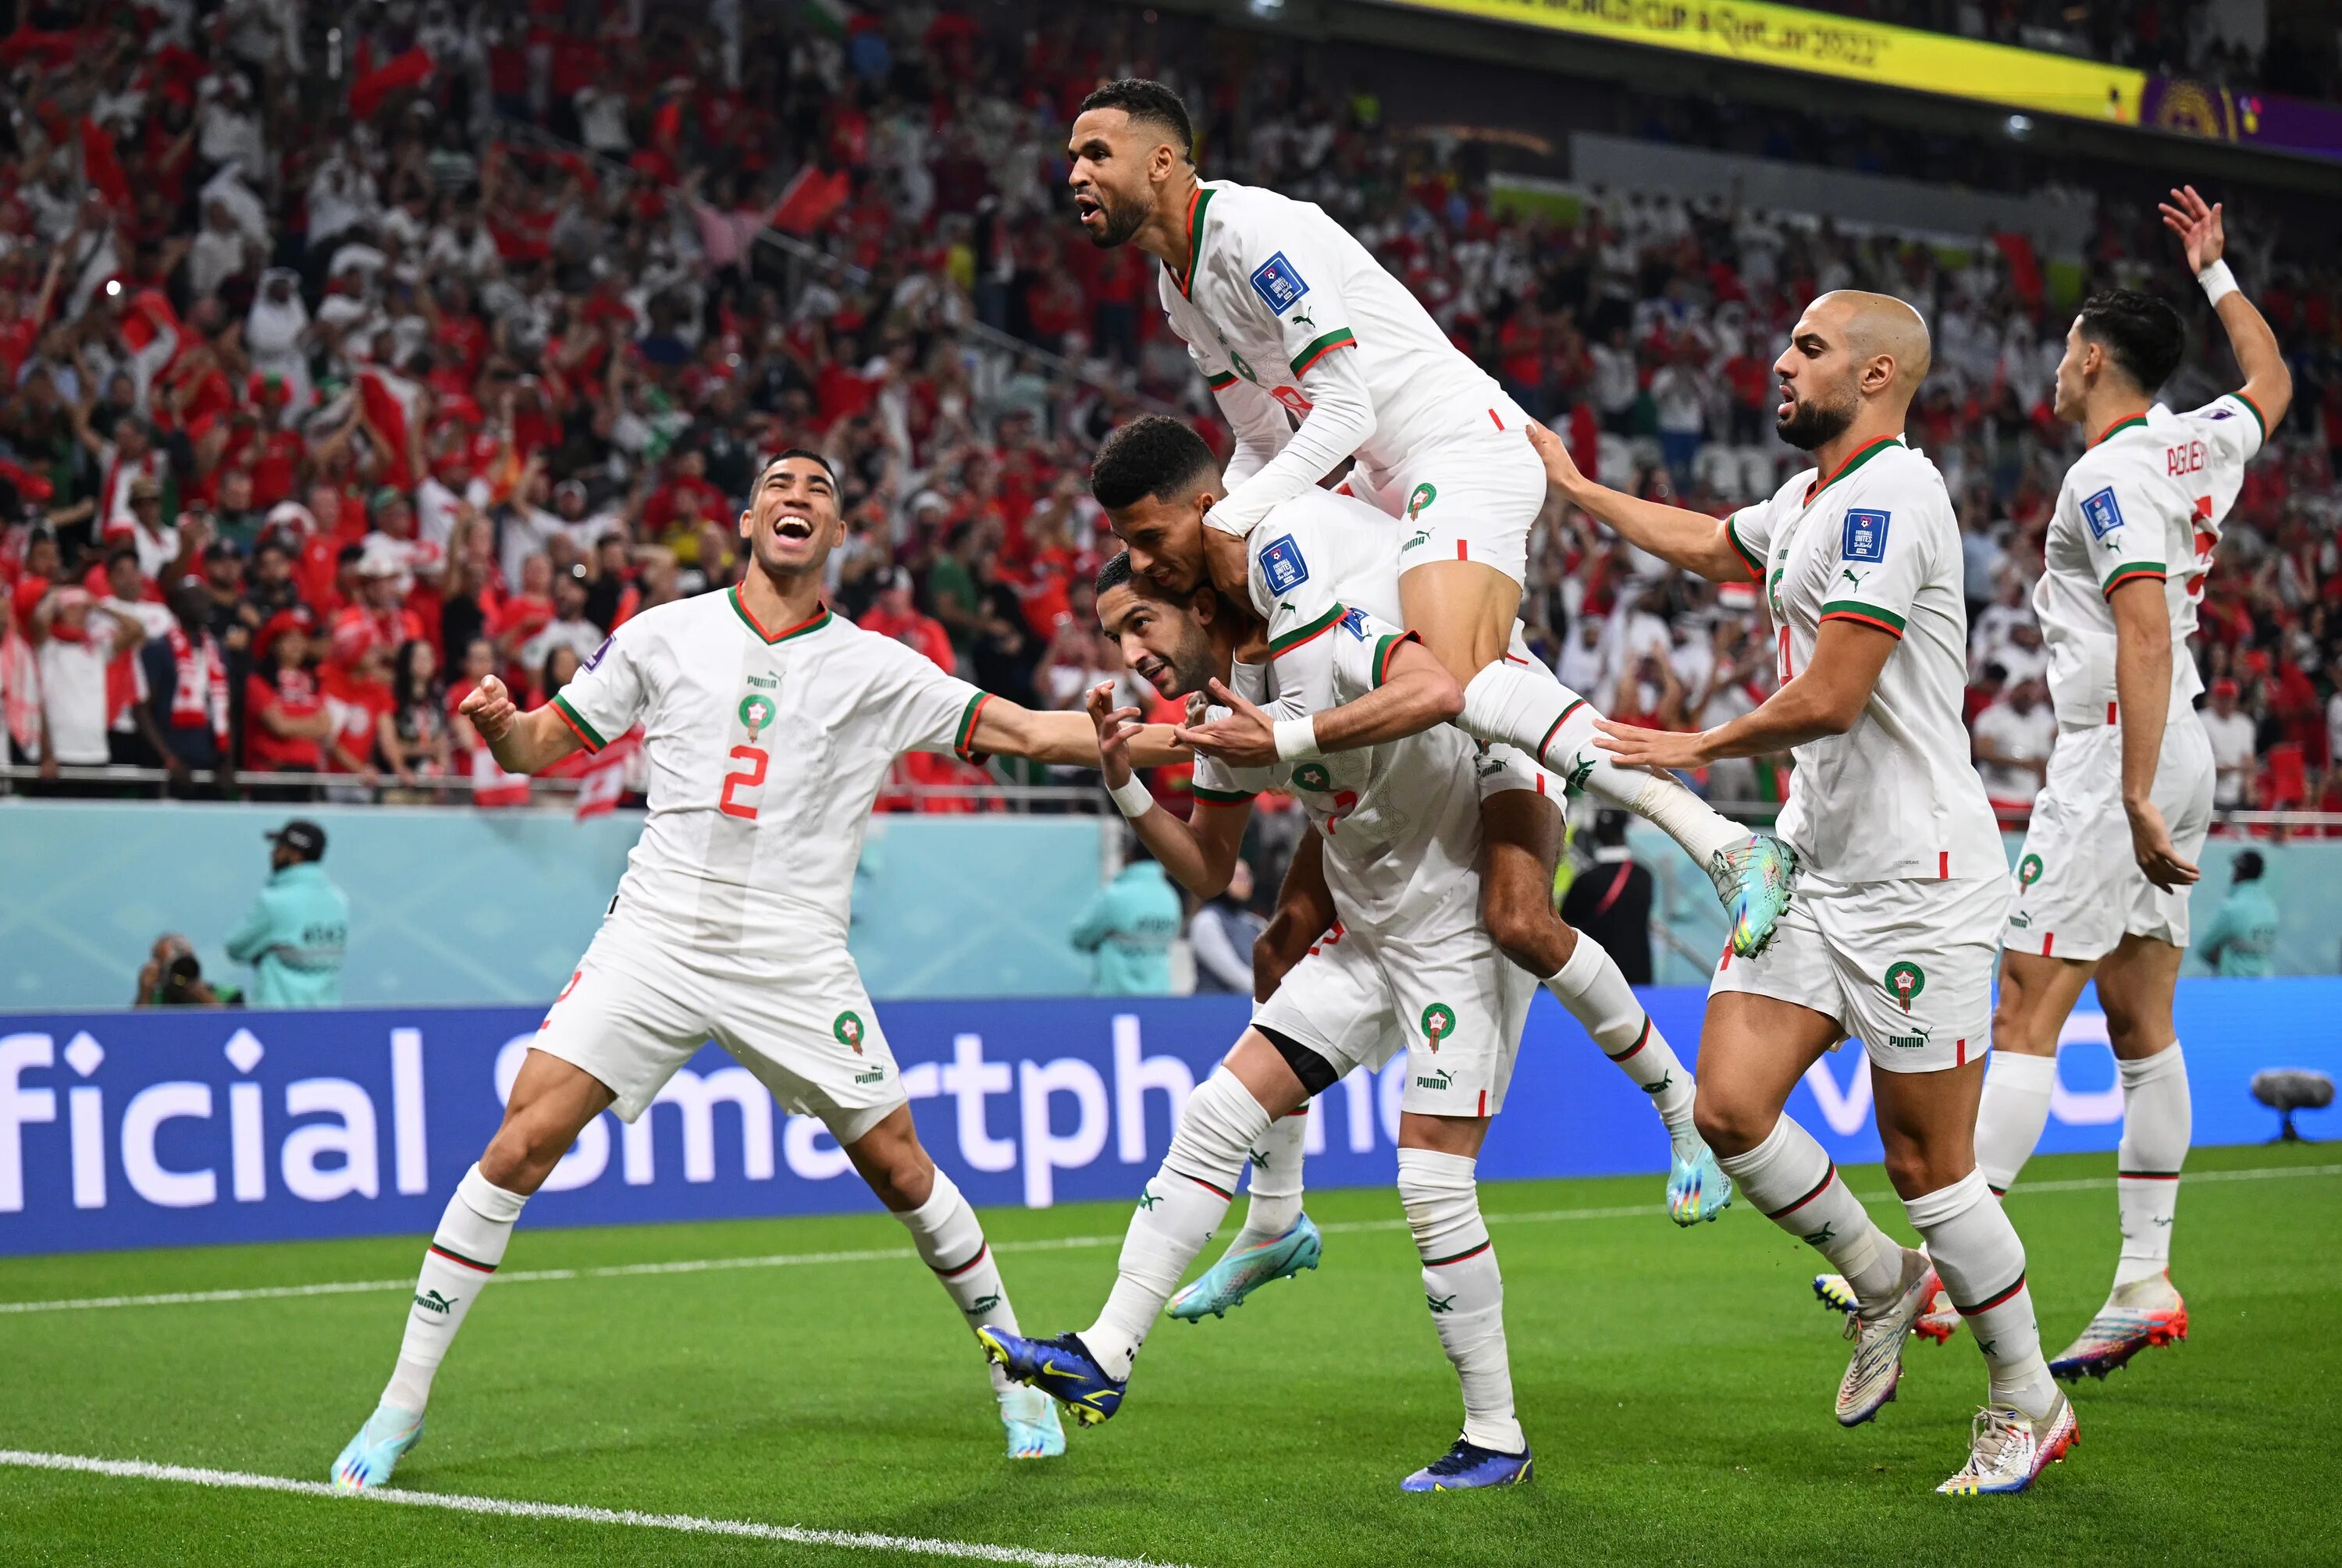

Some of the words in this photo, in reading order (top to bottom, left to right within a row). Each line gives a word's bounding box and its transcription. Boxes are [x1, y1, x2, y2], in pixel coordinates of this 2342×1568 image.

[1401, 535, 1425, 555] PUMA
[747, 674, 777, 688] PUMA
[718, 745, 769, 820] 2
[1889, 1035, 1924, 1047] PUMA
[855, 1072, 884, 1084] PUMA
[1417, 1076, 1447, 1090] PUMA
[0, 1028, 429, 1212] ficial
[495, 1014, 1406, 1208] Smatphn
